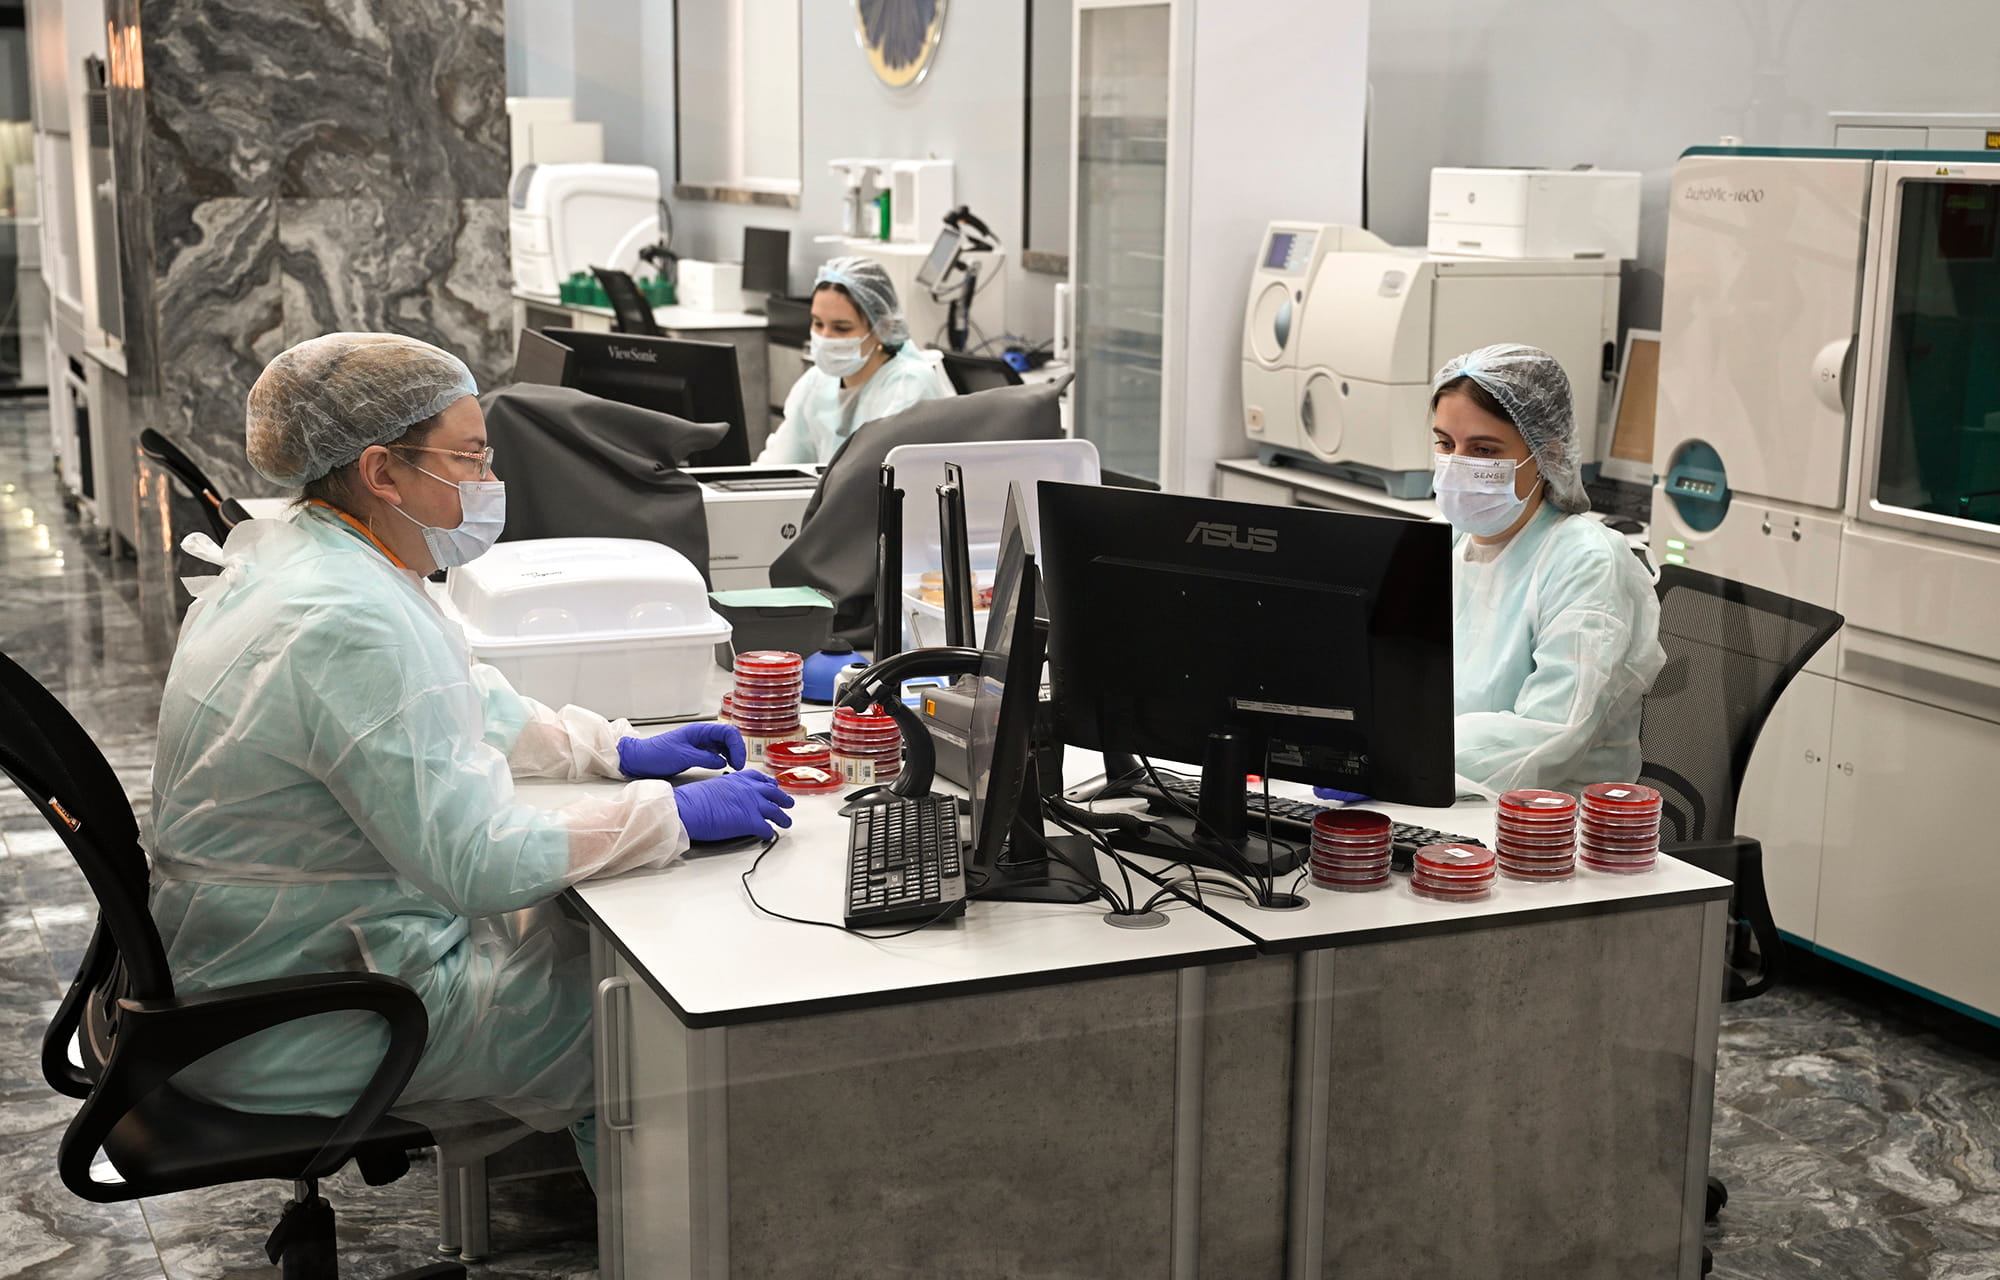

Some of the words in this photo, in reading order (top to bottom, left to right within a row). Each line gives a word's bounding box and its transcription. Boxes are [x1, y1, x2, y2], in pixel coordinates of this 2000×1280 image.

[608, 345, 657, 363] ViewSonic
[1473, 472, 1505, 480] SENSE
[781, 523, 797, 540] hp
[1185, 521, 1278, 553] ASUS
